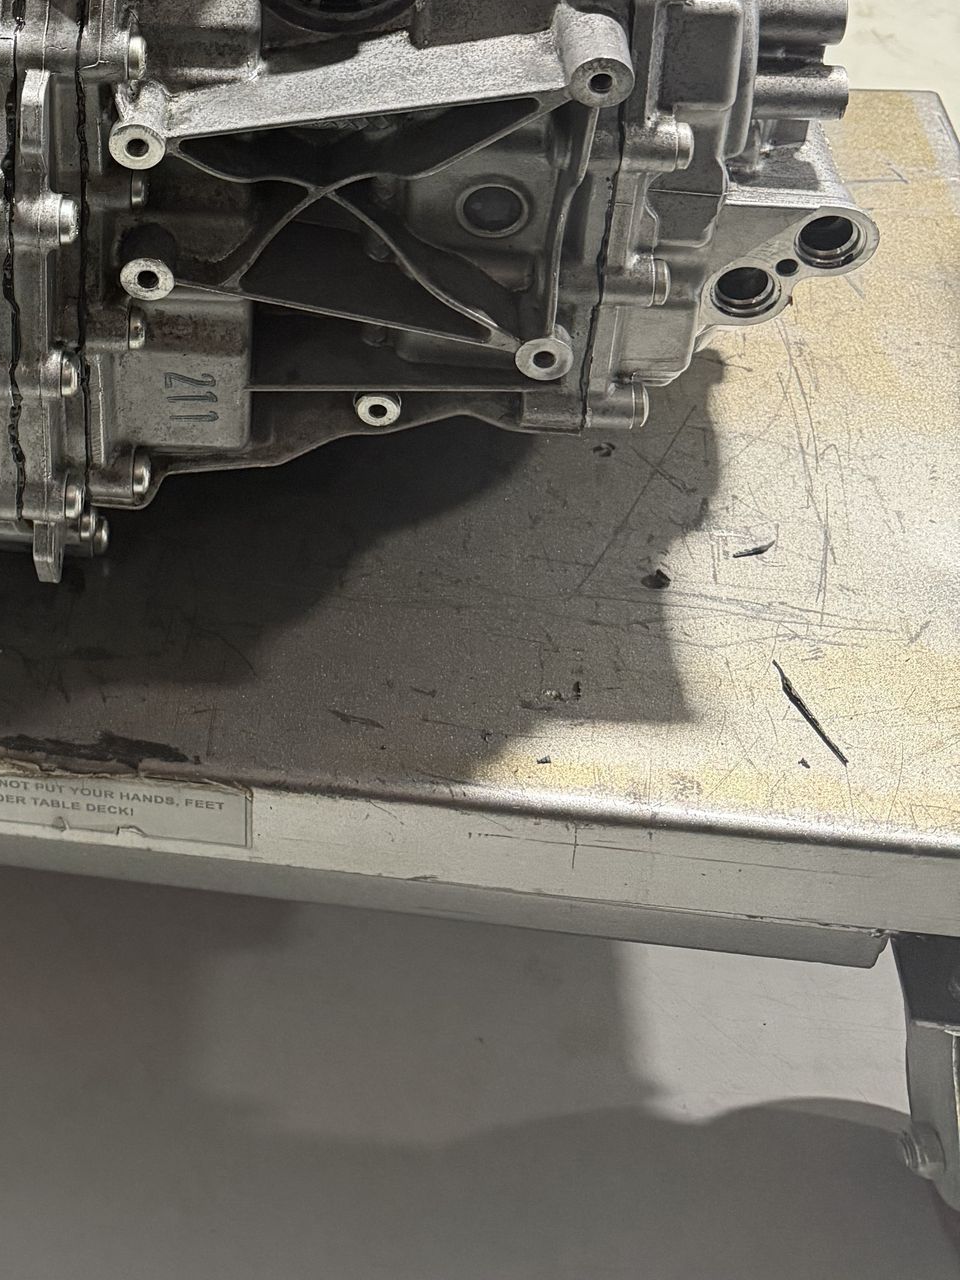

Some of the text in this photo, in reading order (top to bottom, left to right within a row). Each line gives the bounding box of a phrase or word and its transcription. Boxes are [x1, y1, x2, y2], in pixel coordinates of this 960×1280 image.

[31, 796, 81, 810] TABLE
[35, 782, 65, 794] PUT
[69, 786, 115, 800] YOUR
[120, 791, 180, 808] HANDS,
[185, 798, 225, 811] FEET
